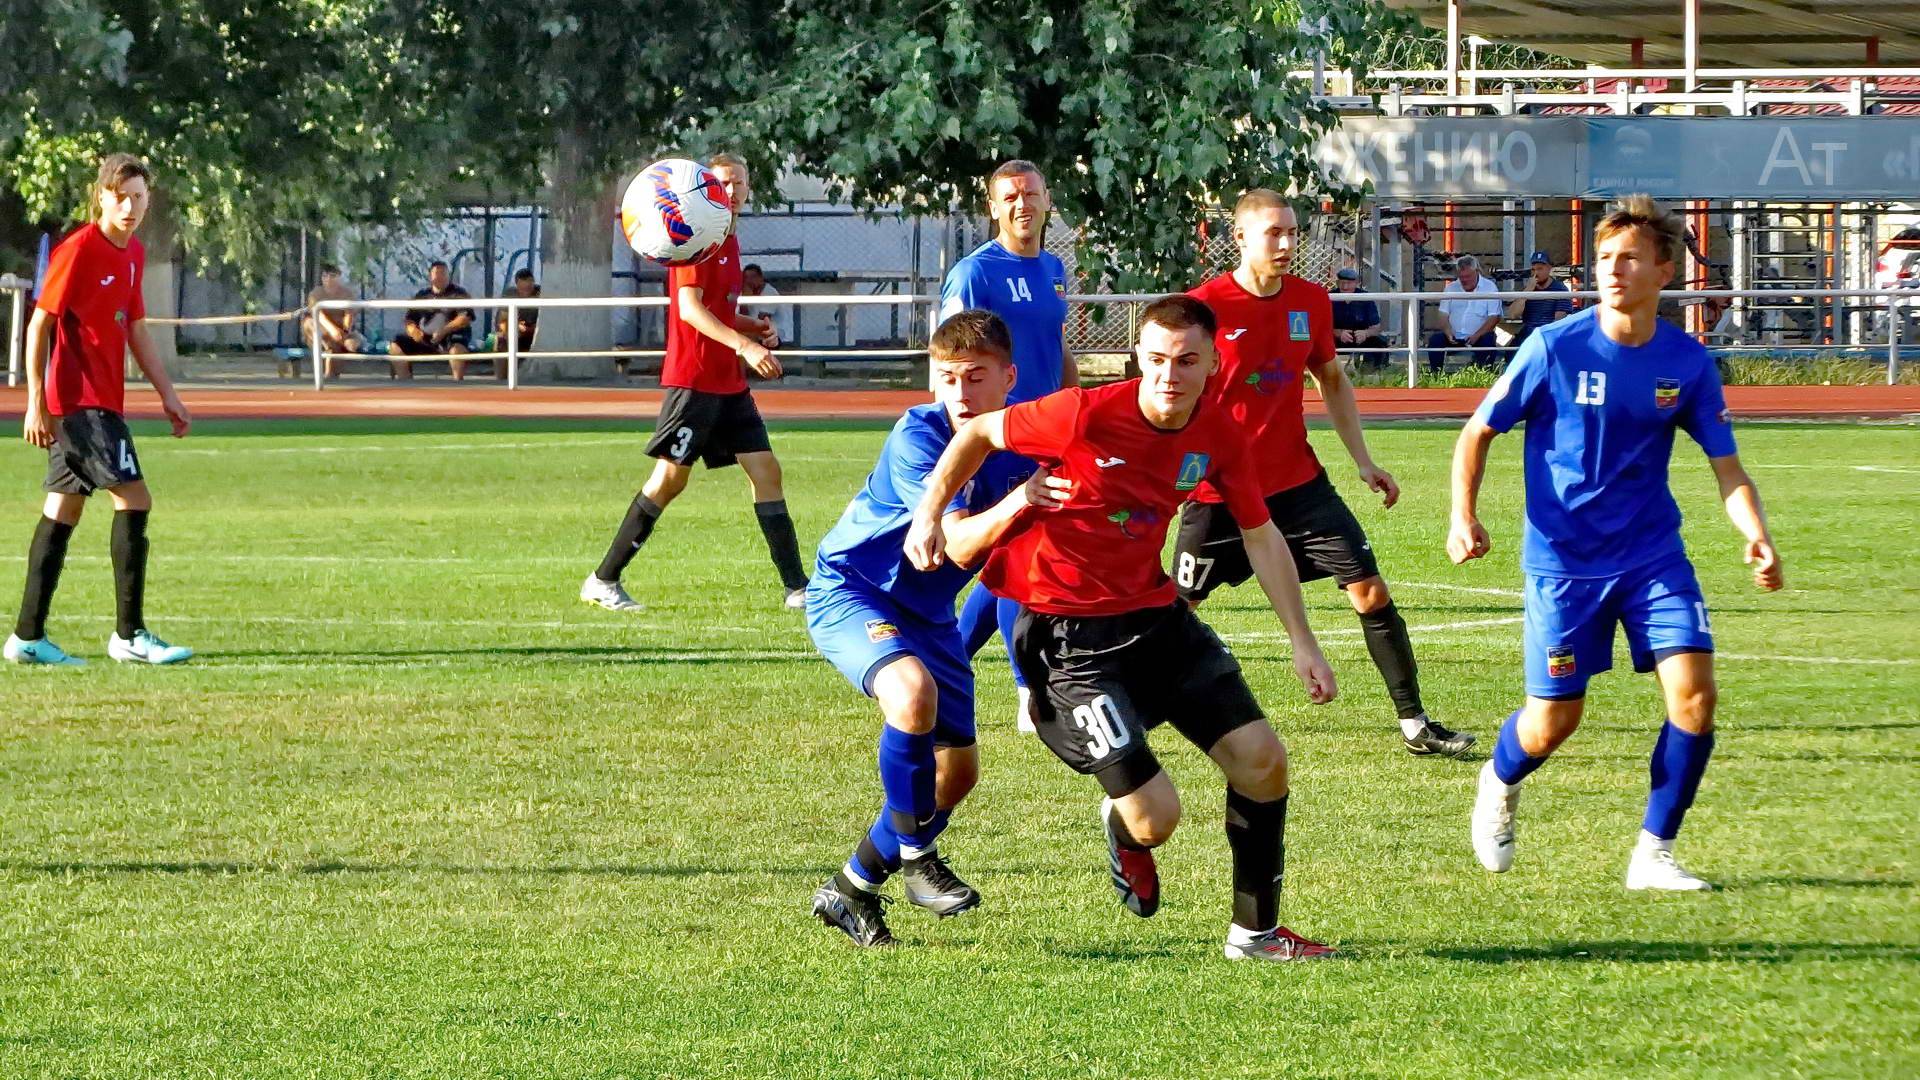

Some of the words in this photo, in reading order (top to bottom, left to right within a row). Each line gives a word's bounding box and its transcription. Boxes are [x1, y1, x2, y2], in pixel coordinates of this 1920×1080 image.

[1006, 277, 1033, 302] 14
[1575, 370, 1607, 406] 13
[119, 439, 137, 475] 4
[670, 426, 693, 458] 3
[1177, 551, 1215, 590] 87
[1694, 601, 1711, 633] 1
[1072, 694, 1130, 760] 30
